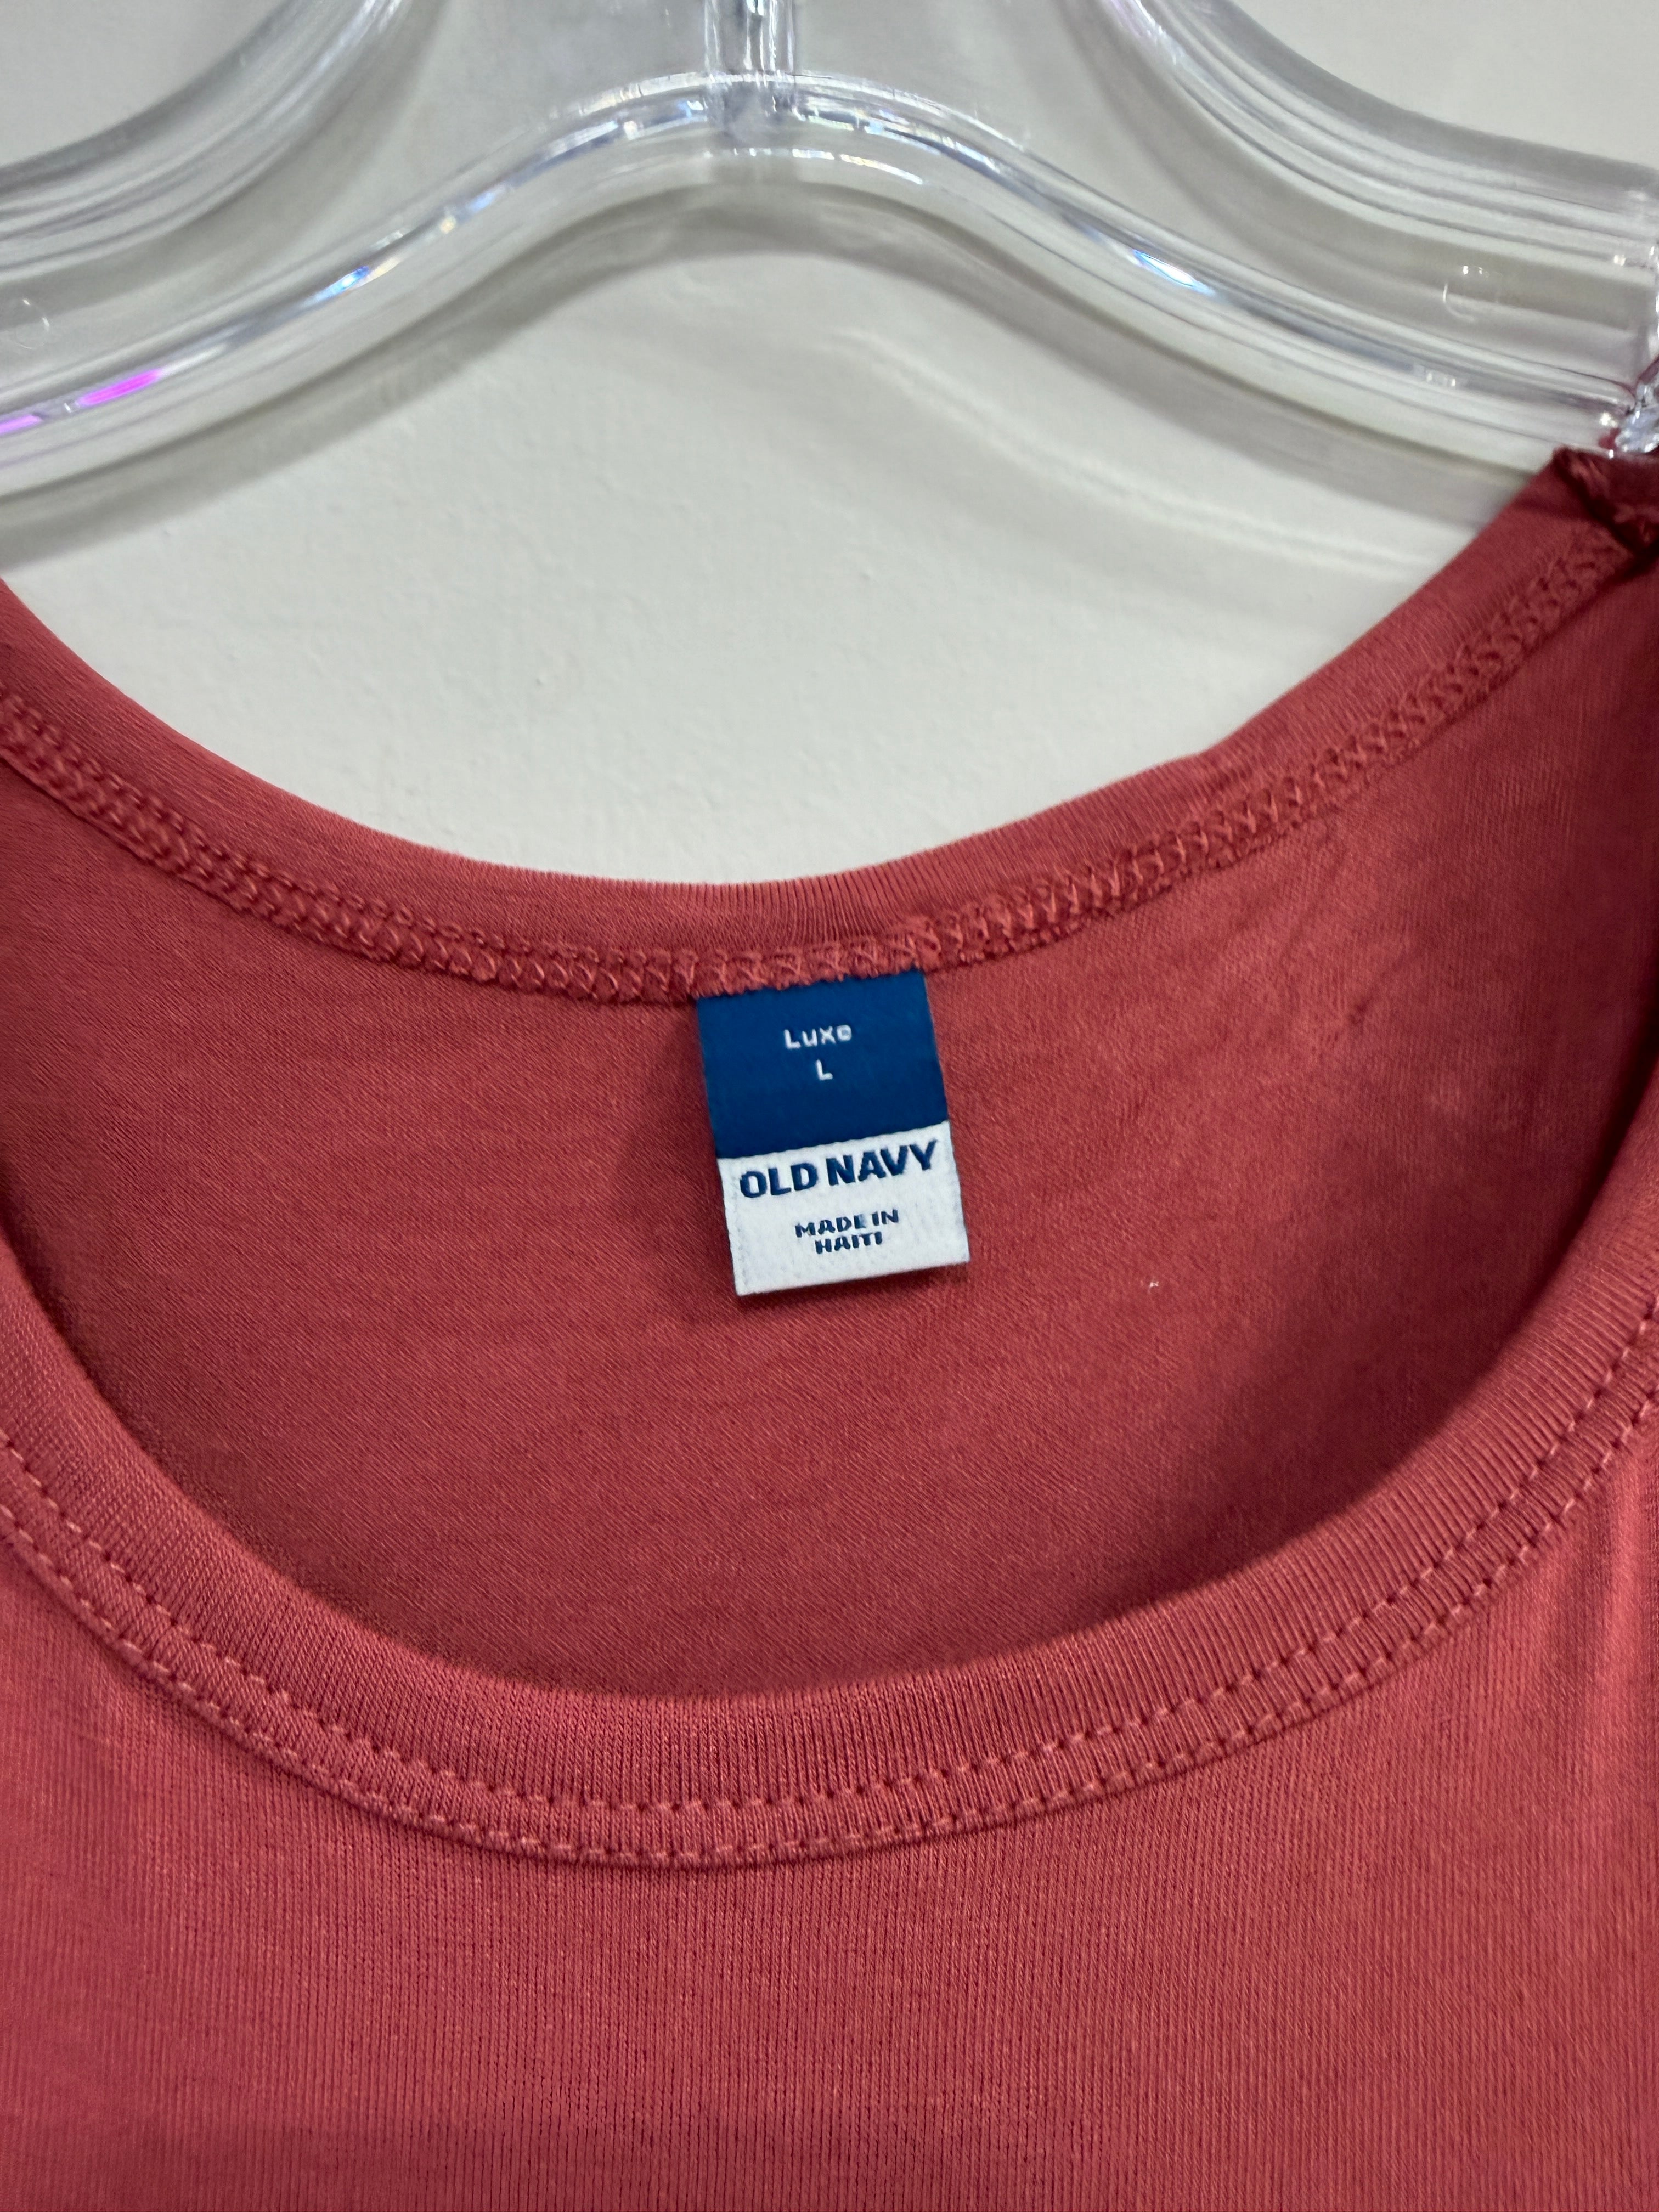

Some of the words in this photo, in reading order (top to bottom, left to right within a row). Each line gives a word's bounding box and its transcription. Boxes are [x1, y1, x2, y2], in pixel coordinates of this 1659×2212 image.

[783, 1024, 853, 1049] Luxe
[816, 1059, 833, 1081] L
[740, 1162, 818, 1198] OLD
[826, 1139, 938, 1186] NAVY
[794, 1214, 867, 1238] MADE
[871, 1209, 899, 1227] IN
[814, 1231, 883, 1254] HAITI
